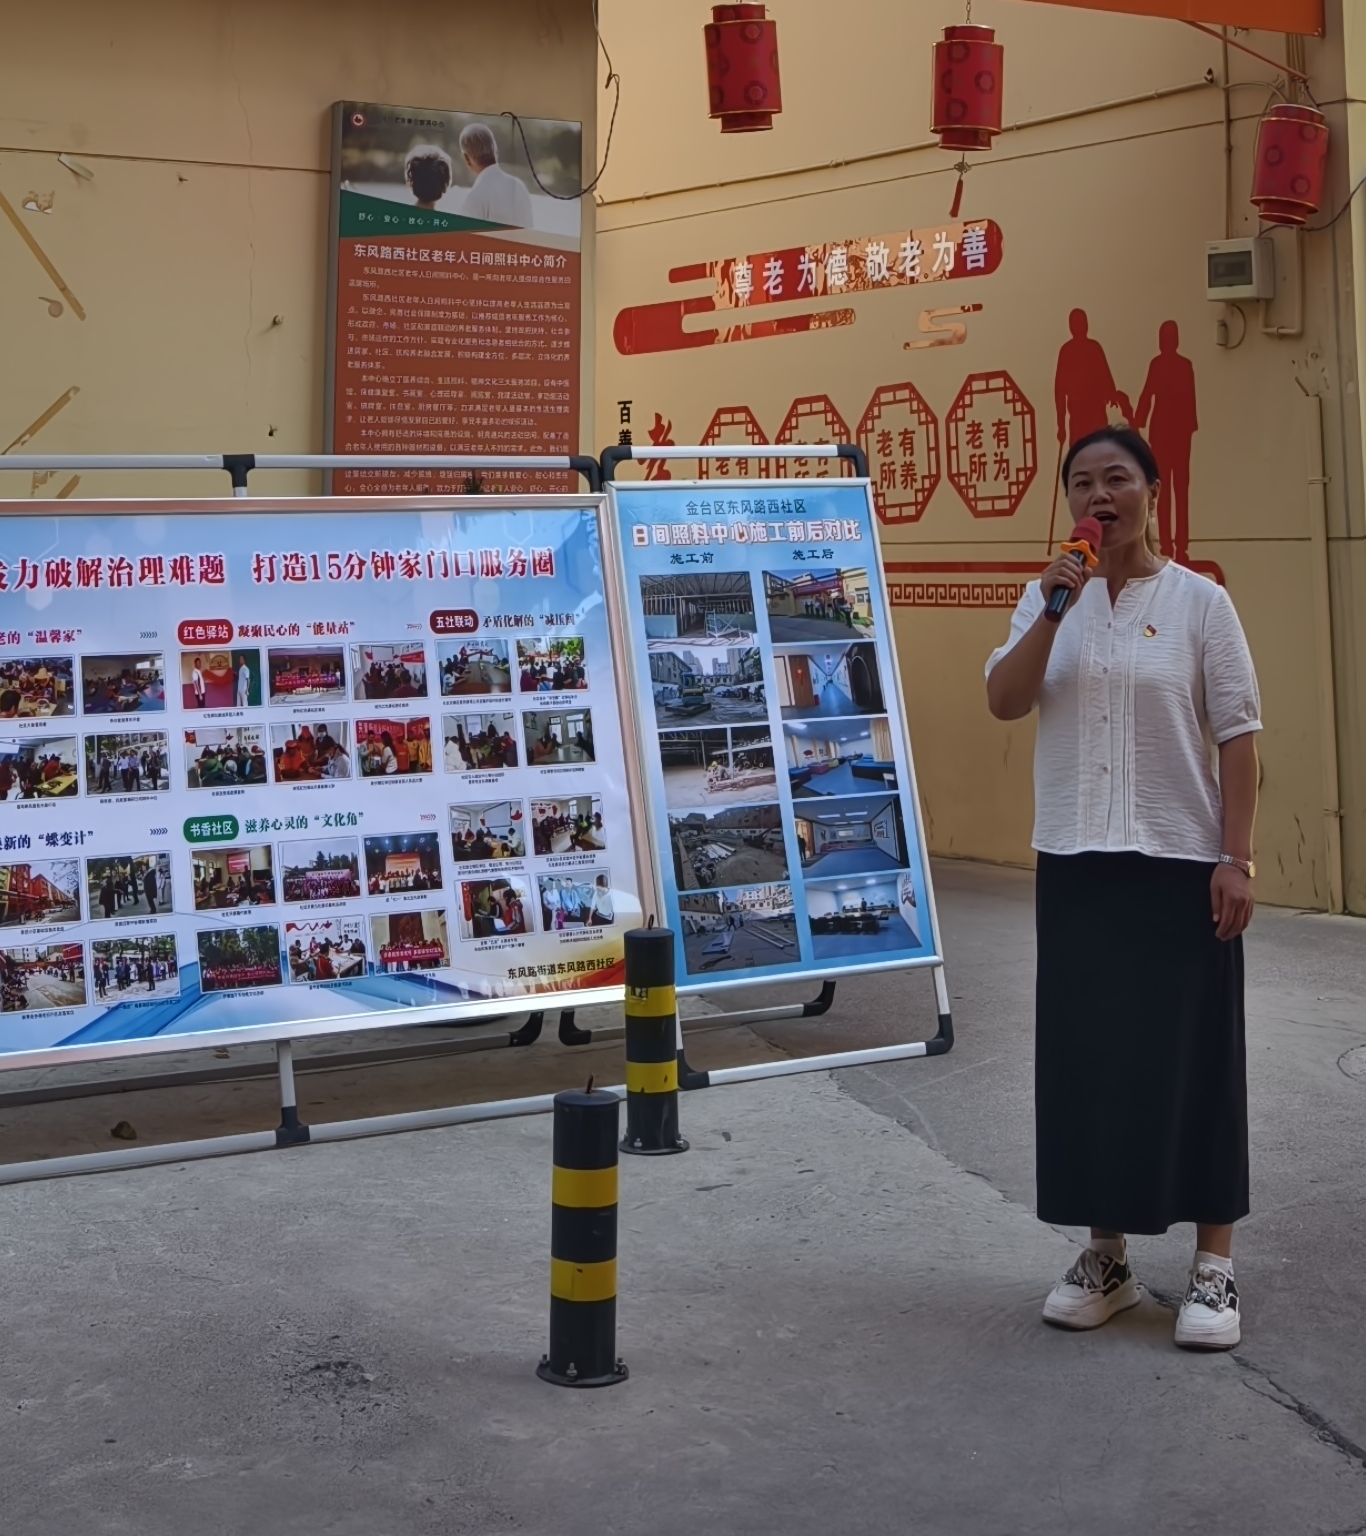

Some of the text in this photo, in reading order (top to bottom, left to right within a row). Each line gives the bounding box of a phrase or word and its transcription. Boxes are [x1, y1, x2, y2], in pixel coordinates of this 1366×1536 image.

[353, 243, 568, 269] 东风路西社区老年人日间照料中心简介
[734, 226, 989, 300] 尊老为德 敬老为善
[876, 427, 916, 458] 老有
[965, 418, 1011, 450] 老有
[879, 460, 918, 491] 所养
[968, 451, 1010, 483] 所为
[686, 497, 807, 516] 金台区东风路西社区
[631, 518, 862, 548] 日间照料中心施工前后对比
[252, 547, 557, 584] 打造15分钟家门口服务圈
[669, 548, 835, 565] 施工前 施工后
[183, 624, 230, 640] 红色驿站
[435, 615, 474, 629] 五社联动
[190, 811, 365, 837] 书香社区 滋养心灵的“文化角”
[507, 956, 616, 980] 东风路街道东风路西社区
